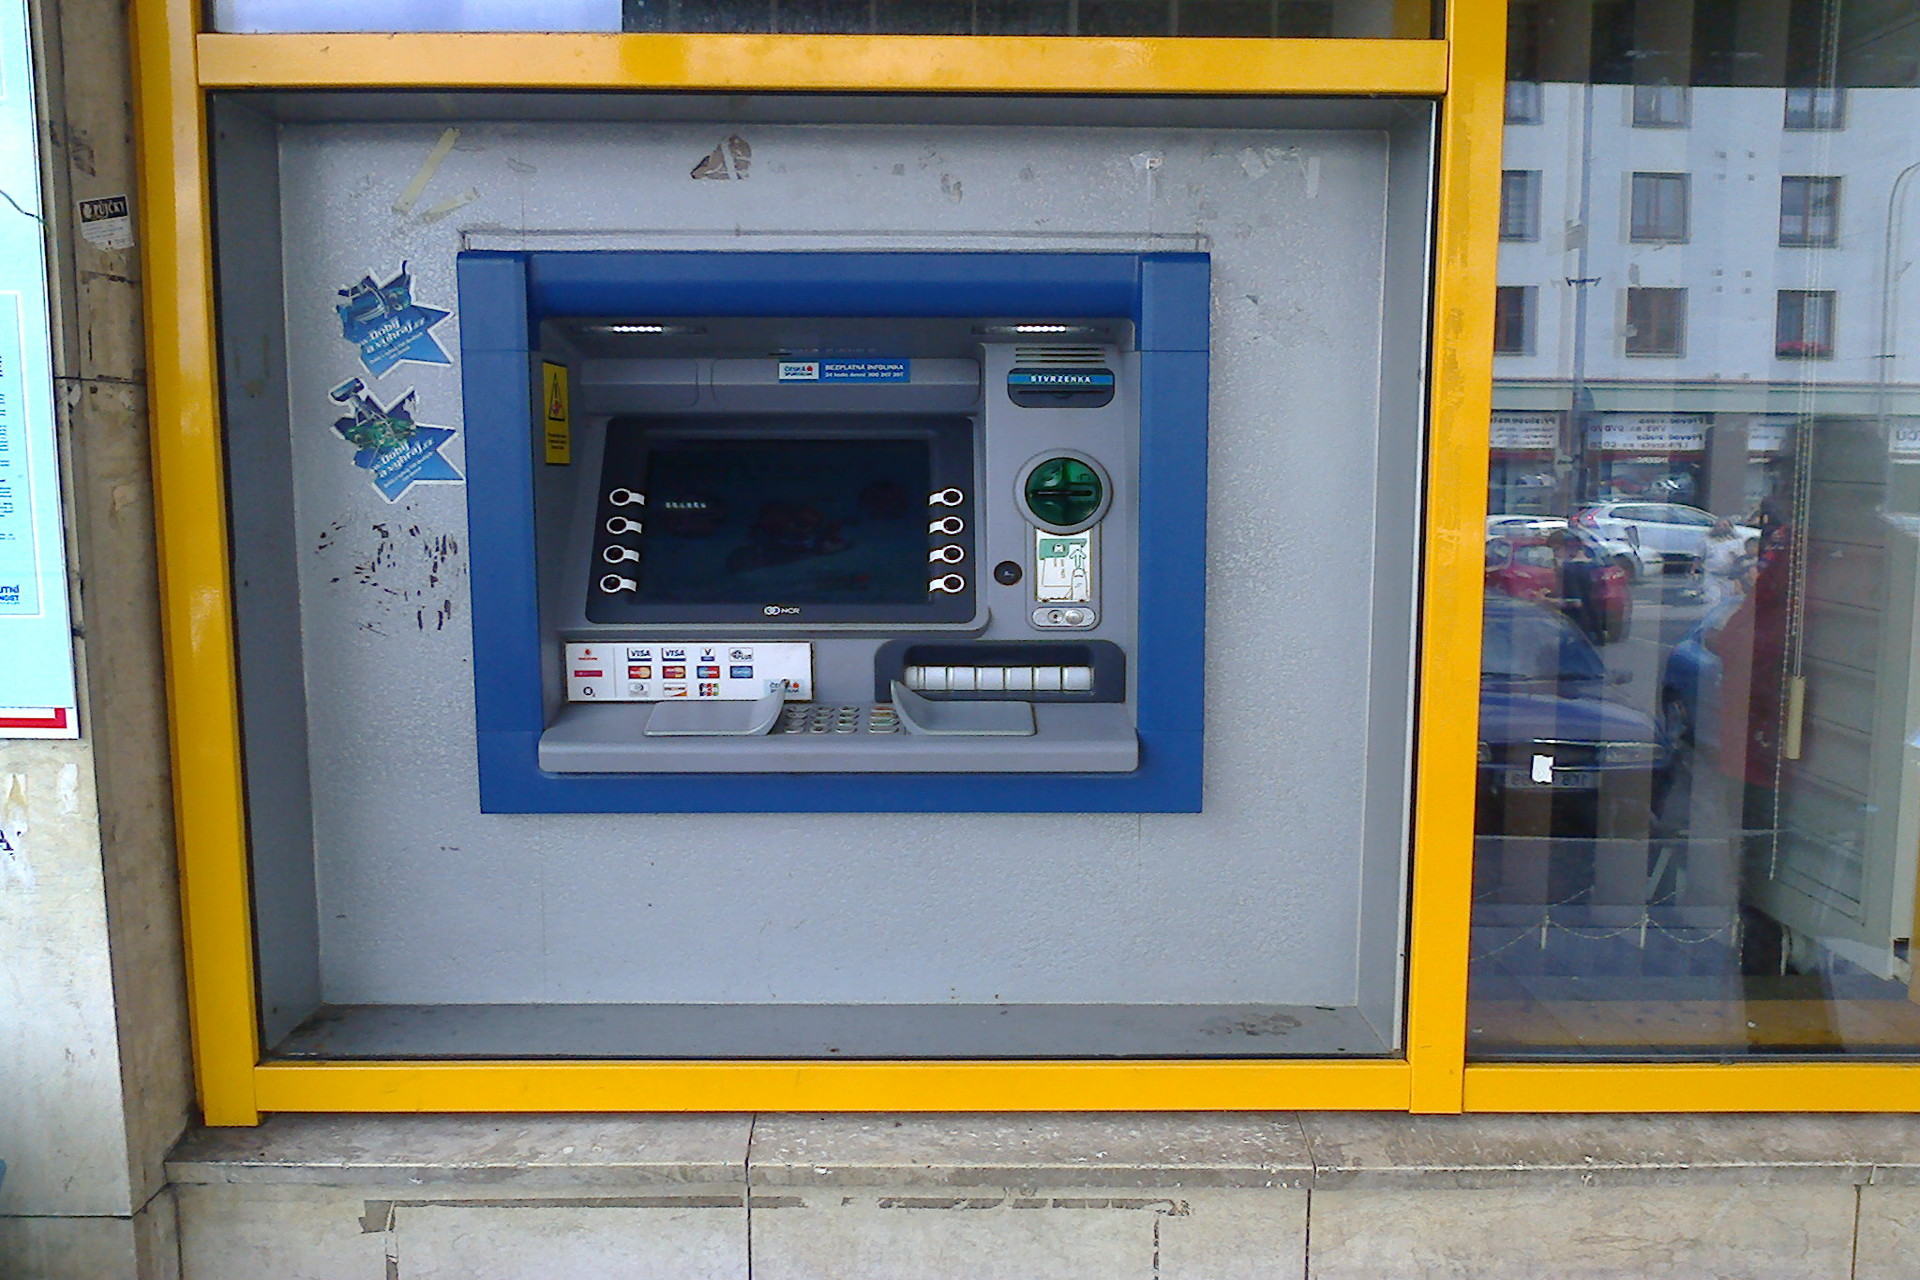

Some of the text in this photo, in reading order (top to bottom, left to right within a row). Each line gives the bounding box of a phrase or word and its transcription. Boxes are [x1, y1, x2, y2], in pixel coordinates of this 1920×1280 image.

[1030, 375, 1092, 383] STVRZENKA
[630, 649, 652, 657] VISA
[665, 649, 686, 657] VISA
